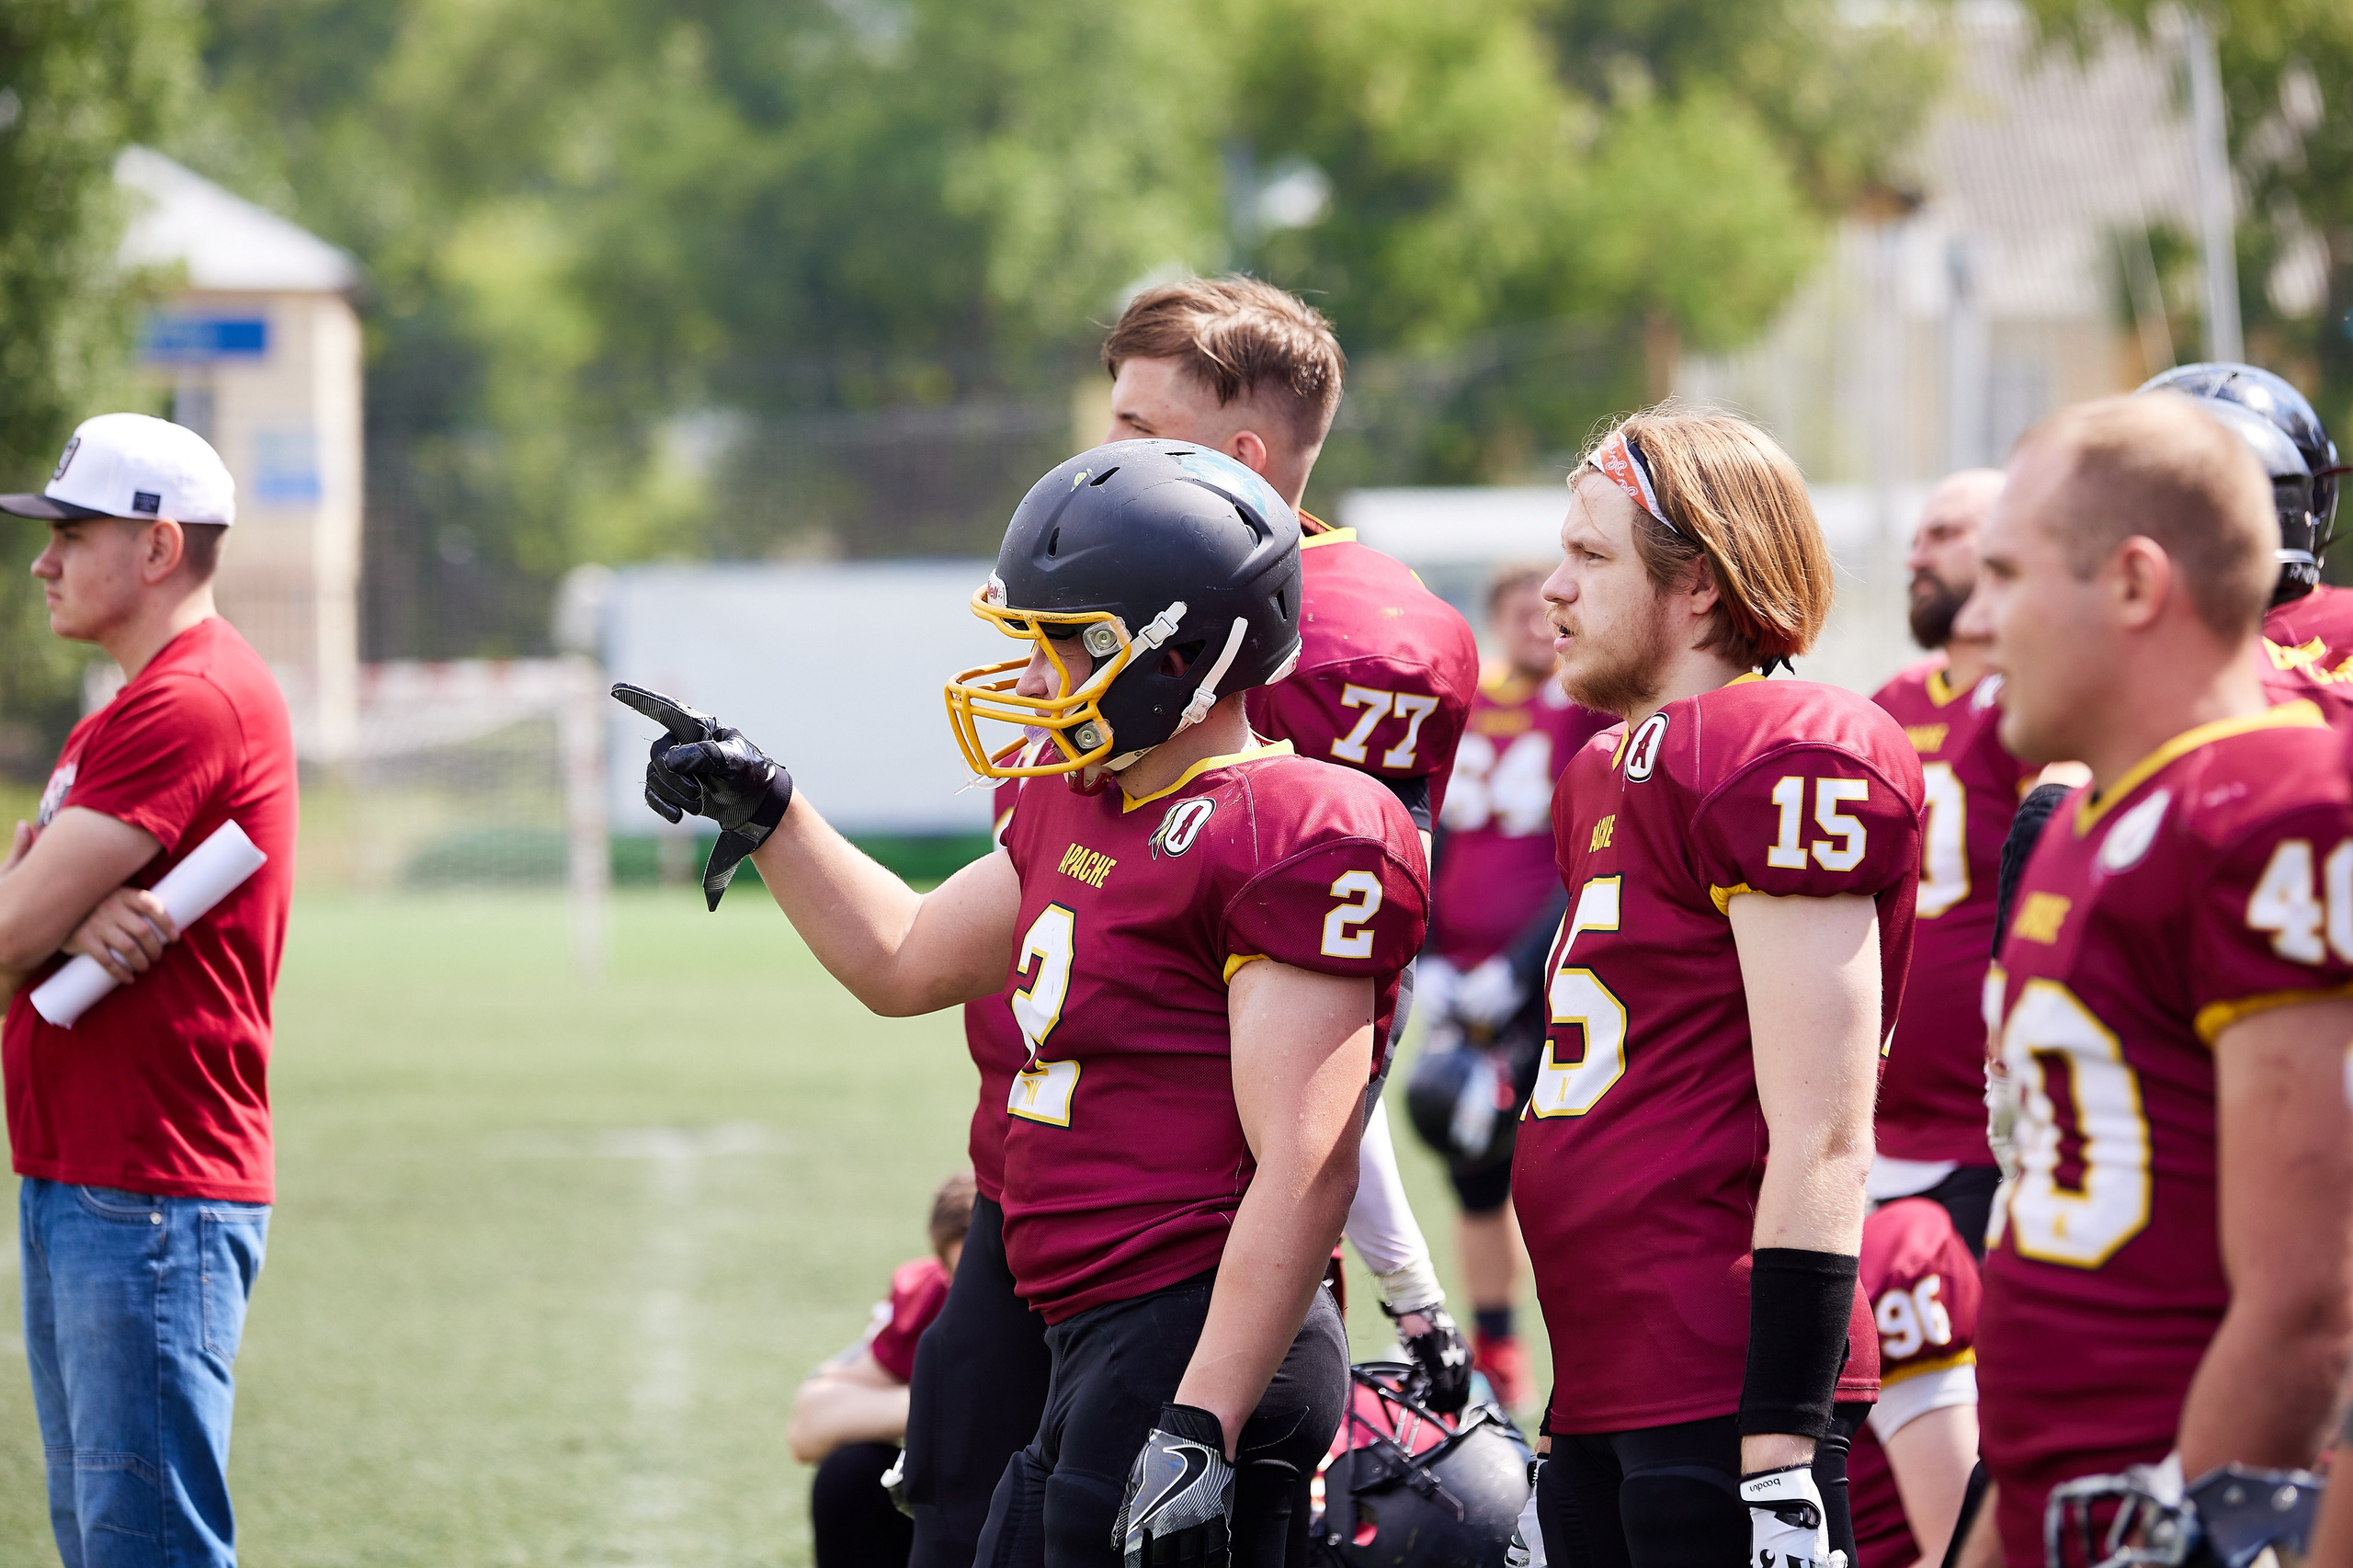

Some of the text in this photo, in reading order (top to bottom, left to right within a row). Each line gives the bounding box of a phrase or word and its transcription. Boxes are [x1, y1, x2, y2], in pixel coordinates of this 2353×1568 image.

[1330, 683, 1439, 769] 77
[1057, 842, 1118, 889] APACHE
[1768, 775, 1870, 872] 15
[1321, 869, 1382, 959] 2
[1007, 901, 1082, 1131] 2
[1520, 872, 1629, 1121] 5
[1981, 965, 2152, 1271] 0
[1875, 1273, 1952, 1360] 96
